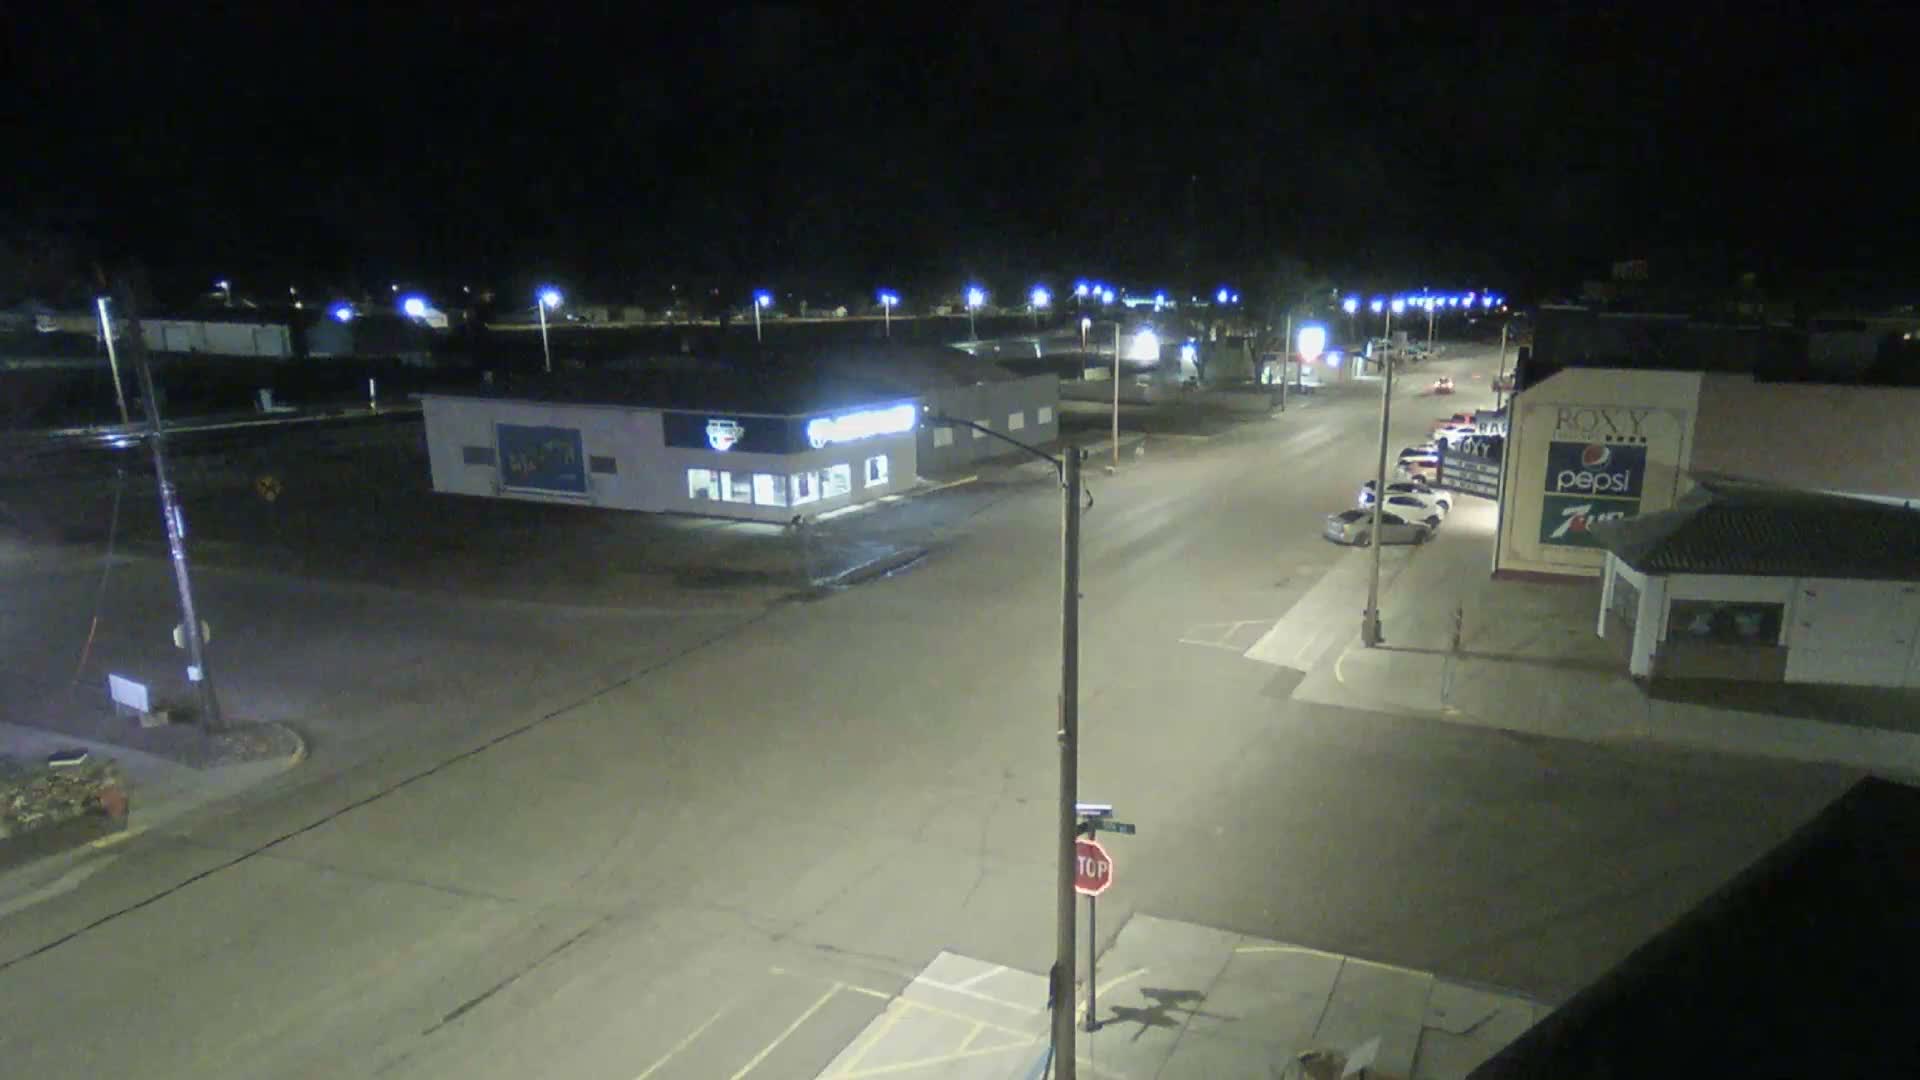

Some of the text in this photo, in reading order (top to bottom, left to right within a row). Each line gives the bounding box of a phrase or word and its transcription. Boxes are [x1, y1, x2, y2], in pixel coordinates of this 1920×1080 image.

[1556, 408, 1649, 434] ROXY
[1557, 469, 1630, 495] pepsi
[1077, 855, 1107, 879] TOP
